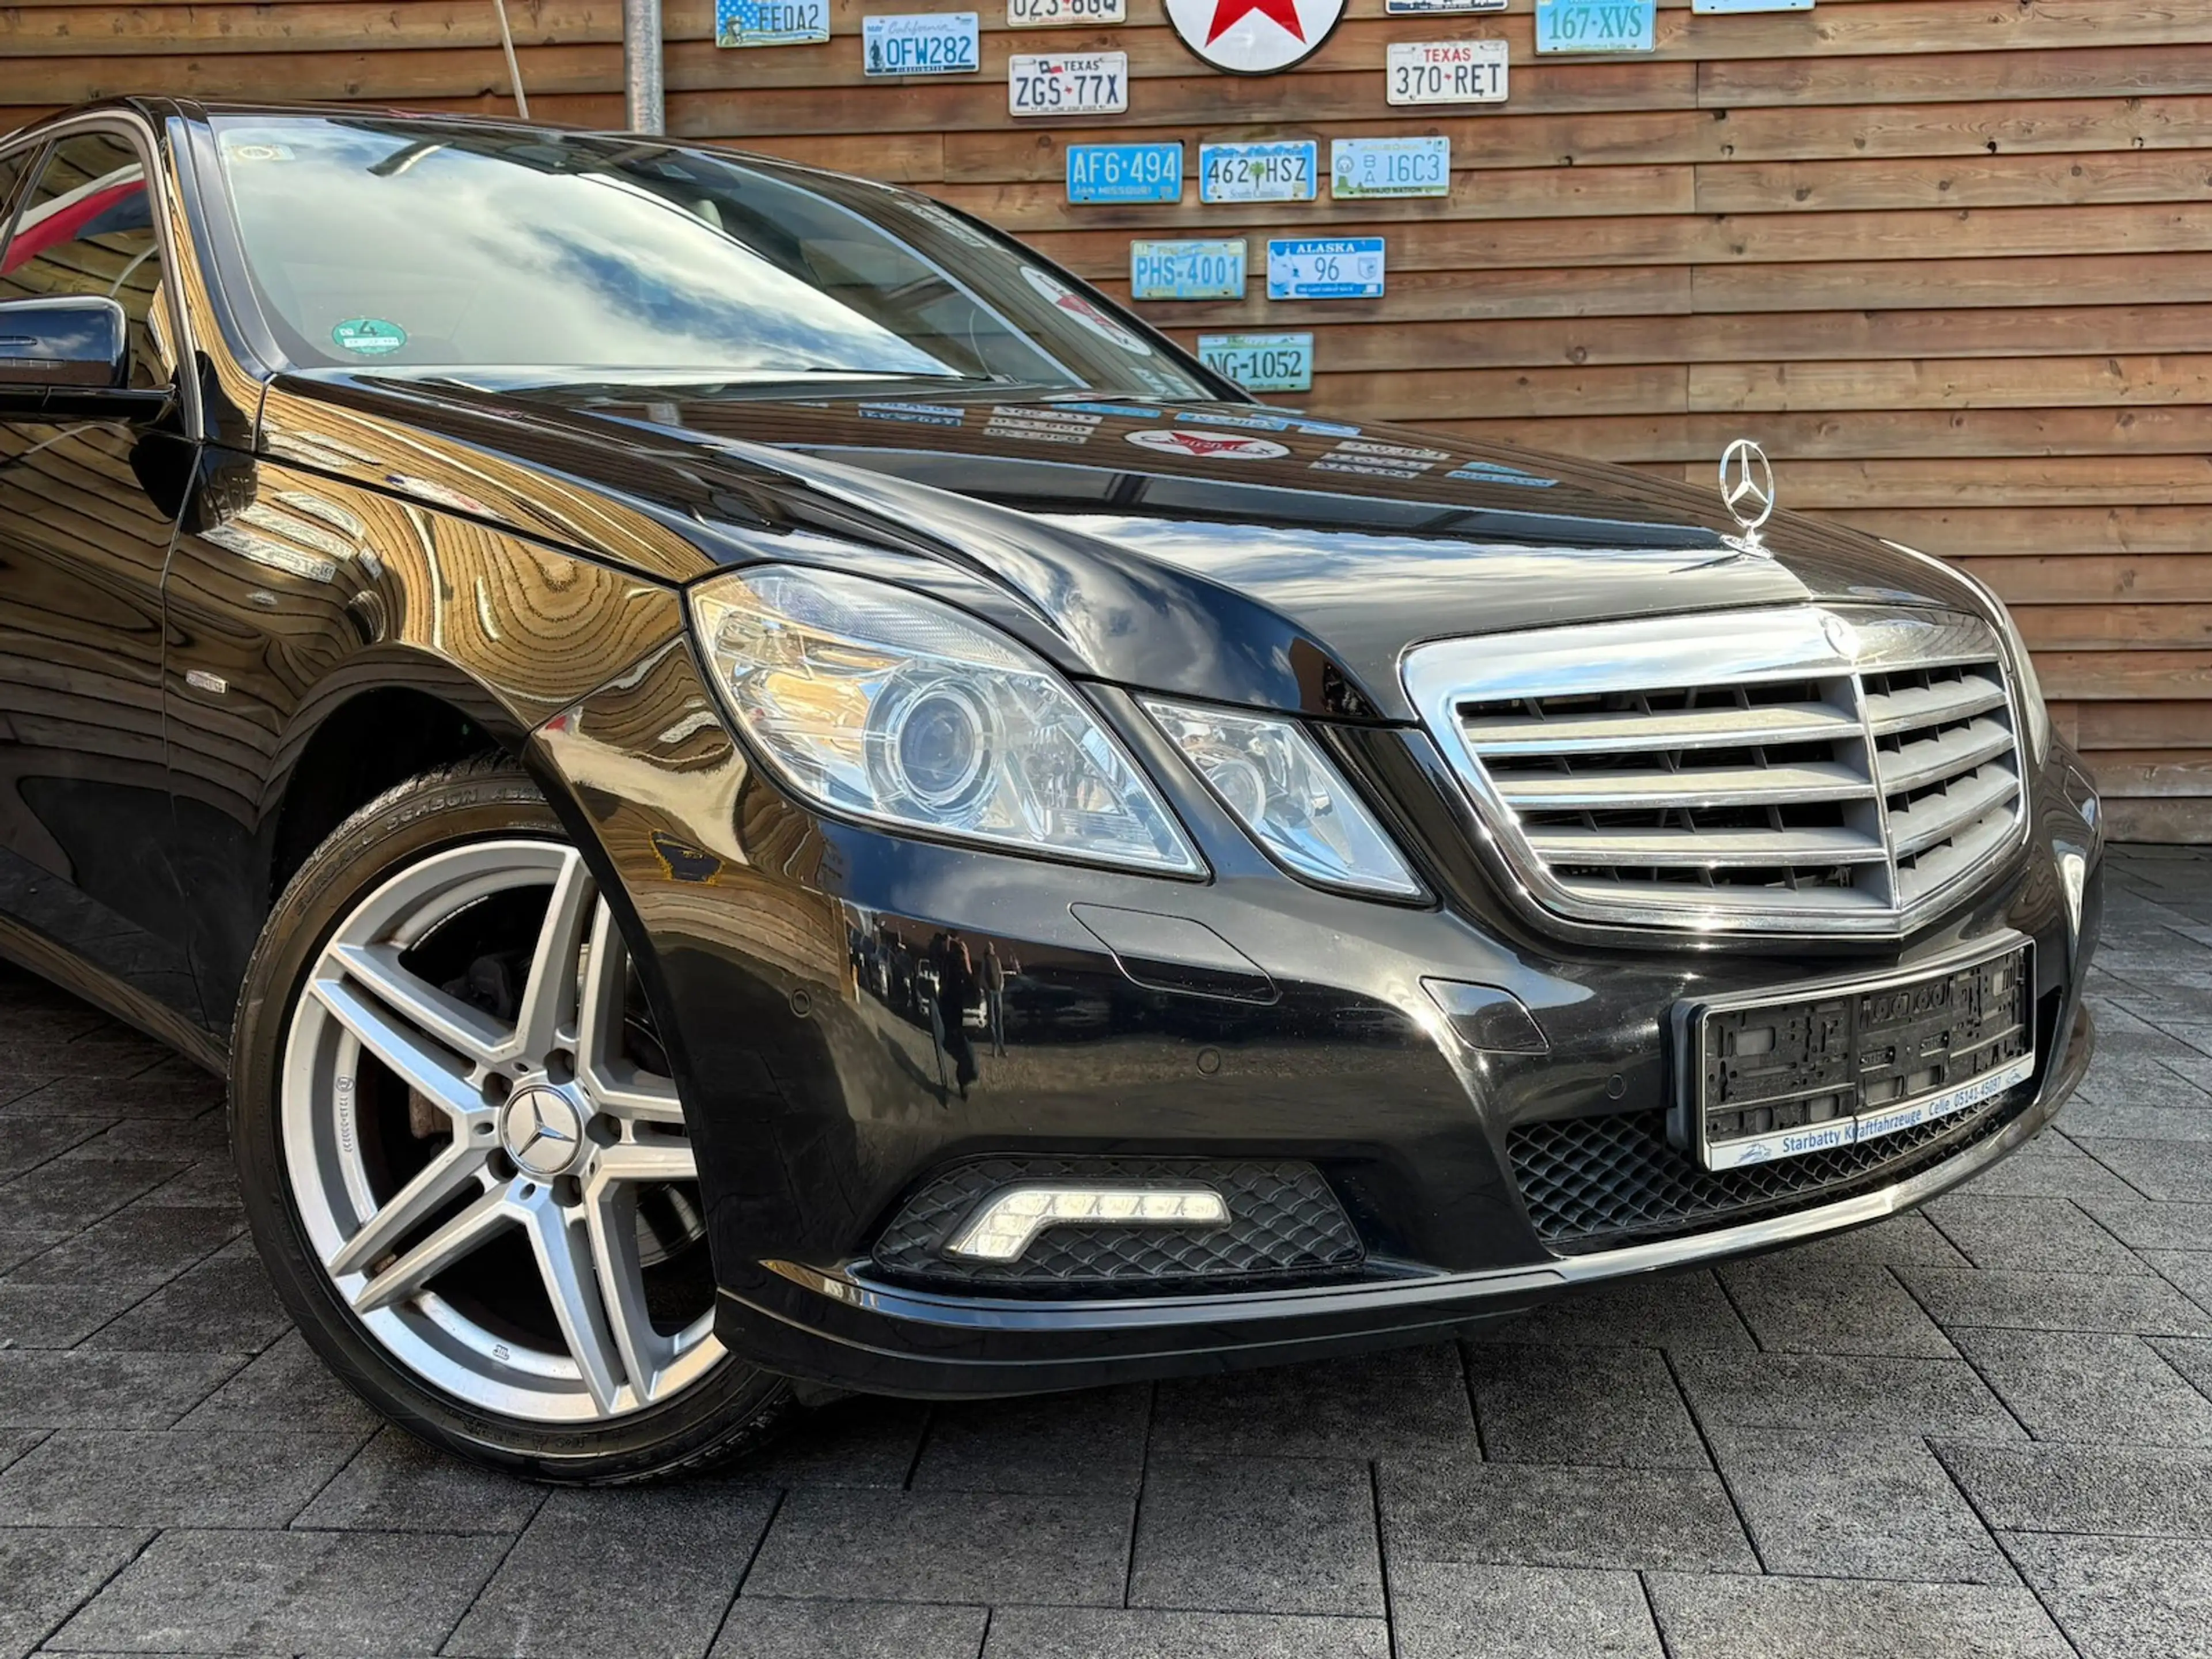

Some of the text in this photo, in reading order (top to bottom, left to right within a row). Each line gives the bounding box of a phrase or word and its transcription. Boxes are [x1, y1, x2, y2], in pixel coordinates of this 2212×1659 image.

[1063, 60, 1100, 71] TEXAS
[1423, 48, 1471, 63] TEXAS
[1016, 74, 1118, 107] ZGS 77X
[1396, 64, 1501, 95] 370 RET
[1207, 157, 1306, 184] 462 HSZ
[1387, 154, 1440, 182] 16C3
[1297, 243, 1355, 253] ALASKA
[1137, 256, 1238, 285] PHS-4001
[1315, 257, 1340, 282] 96
[1783, 1130, 1841, 1153] Starbatty
